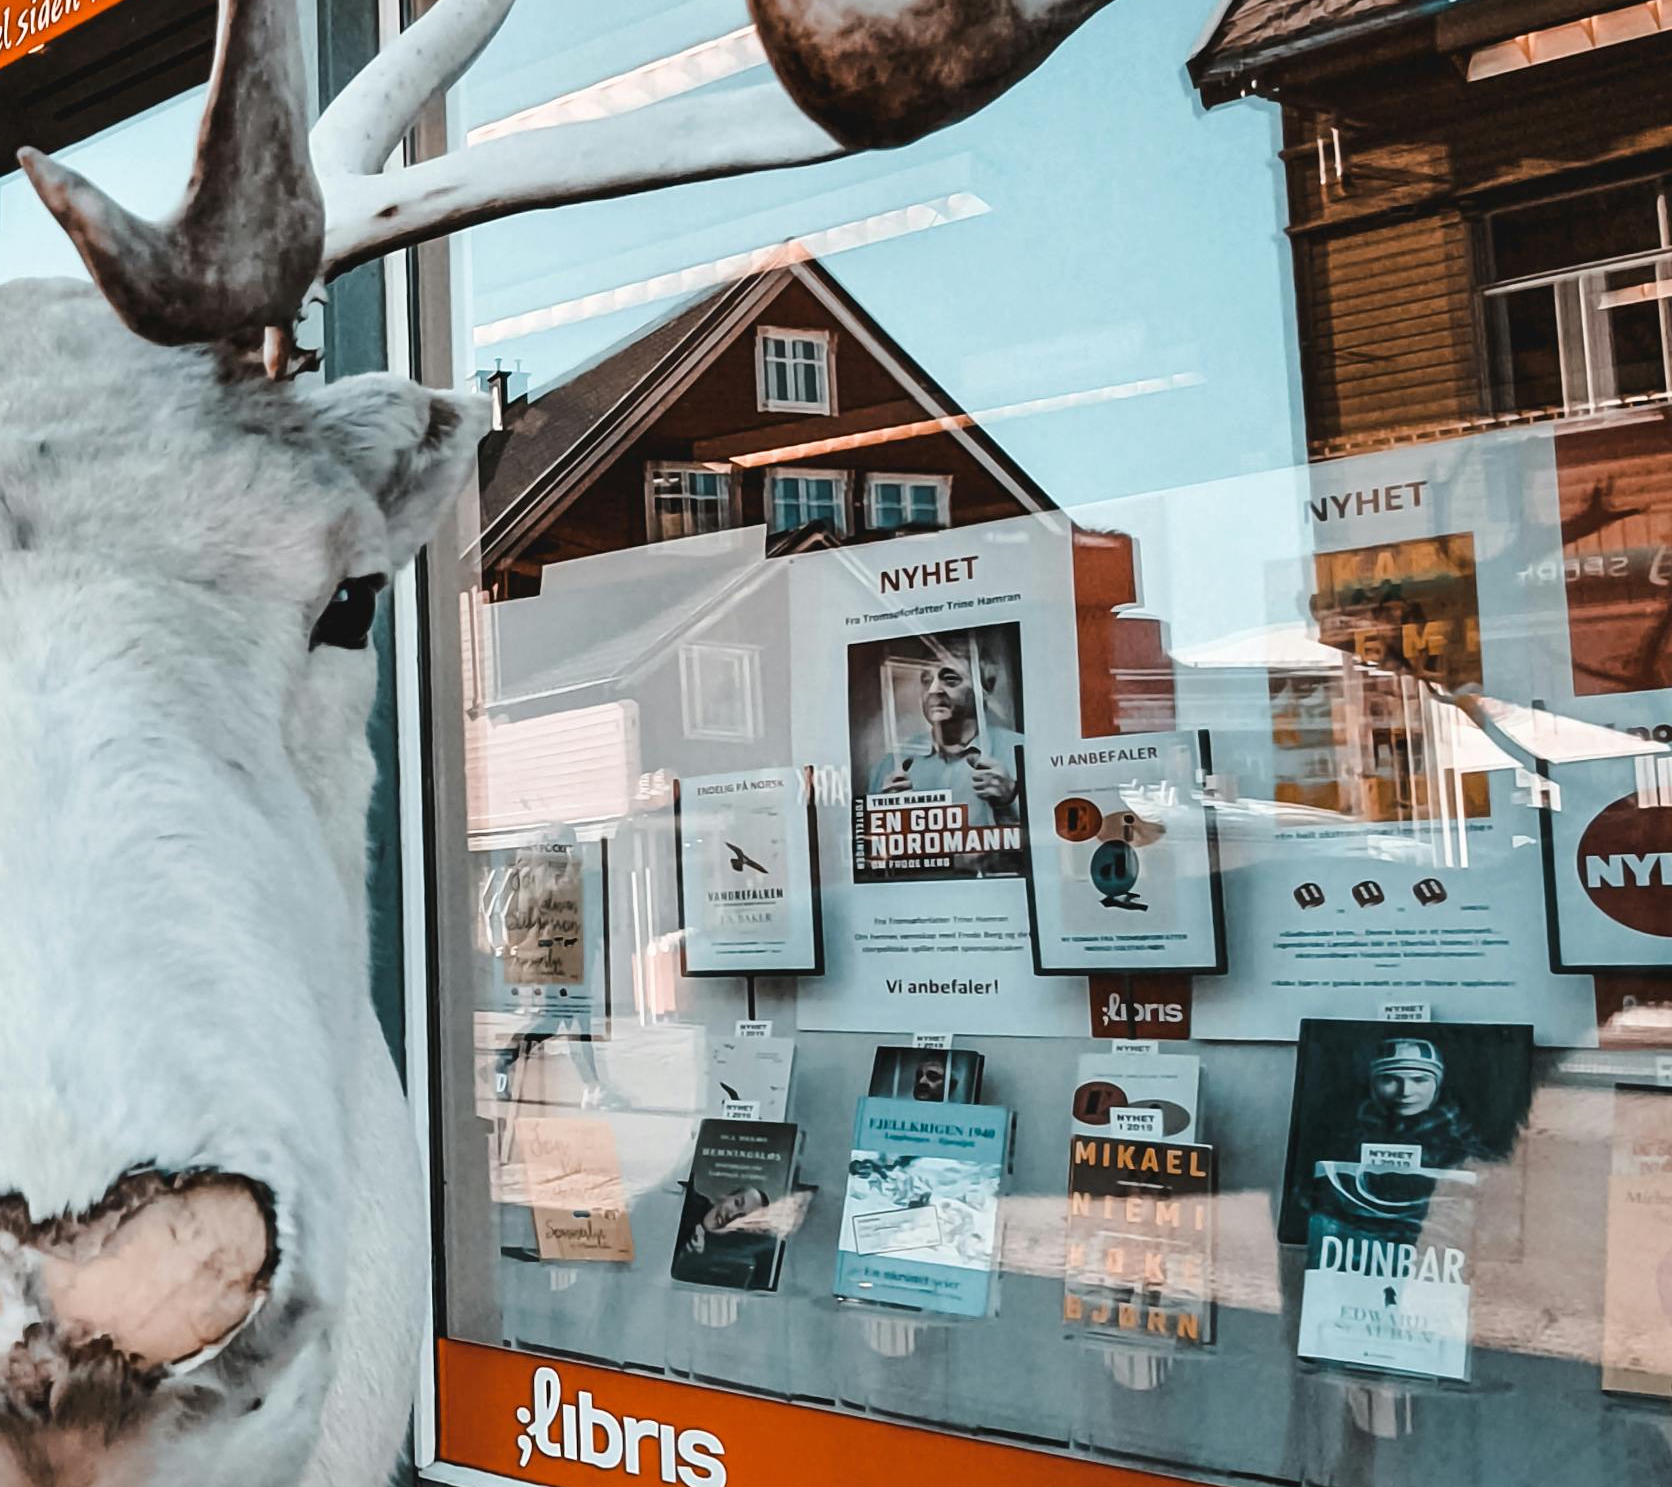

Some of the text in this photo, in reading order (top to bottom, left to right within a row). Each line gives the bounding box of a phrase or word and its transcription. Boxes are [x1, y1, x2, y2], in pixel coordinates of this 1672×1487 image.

[1305, 480, 1428, 524] NYHET
[880, 555, 979, 595] NYHET
[1050, 747, 1158, 767] VI ANBEFALER
[870, 806, 963, 834] EN GOD
[870, 827, 1021, 857] NORDMANN
[707, 888, 784, 902] VANDREFALKEN
[887, 979, 999, 994] Vi anbefaler!
[869, 1117, 964, 1136] FJELLKRIGEN
[1117, 1114, 1155, 1123] NYHET
[1075, 1141, 1207, 1177] MIKAEL
[1369, 1150, 1413, 1160] NYHET
[1072, 1191, 1205, 1230] NIEMI
[1320, 1236, 1466, 1285] DUNBAR
[1065, 1295, 1199, 1339] BJØRN
